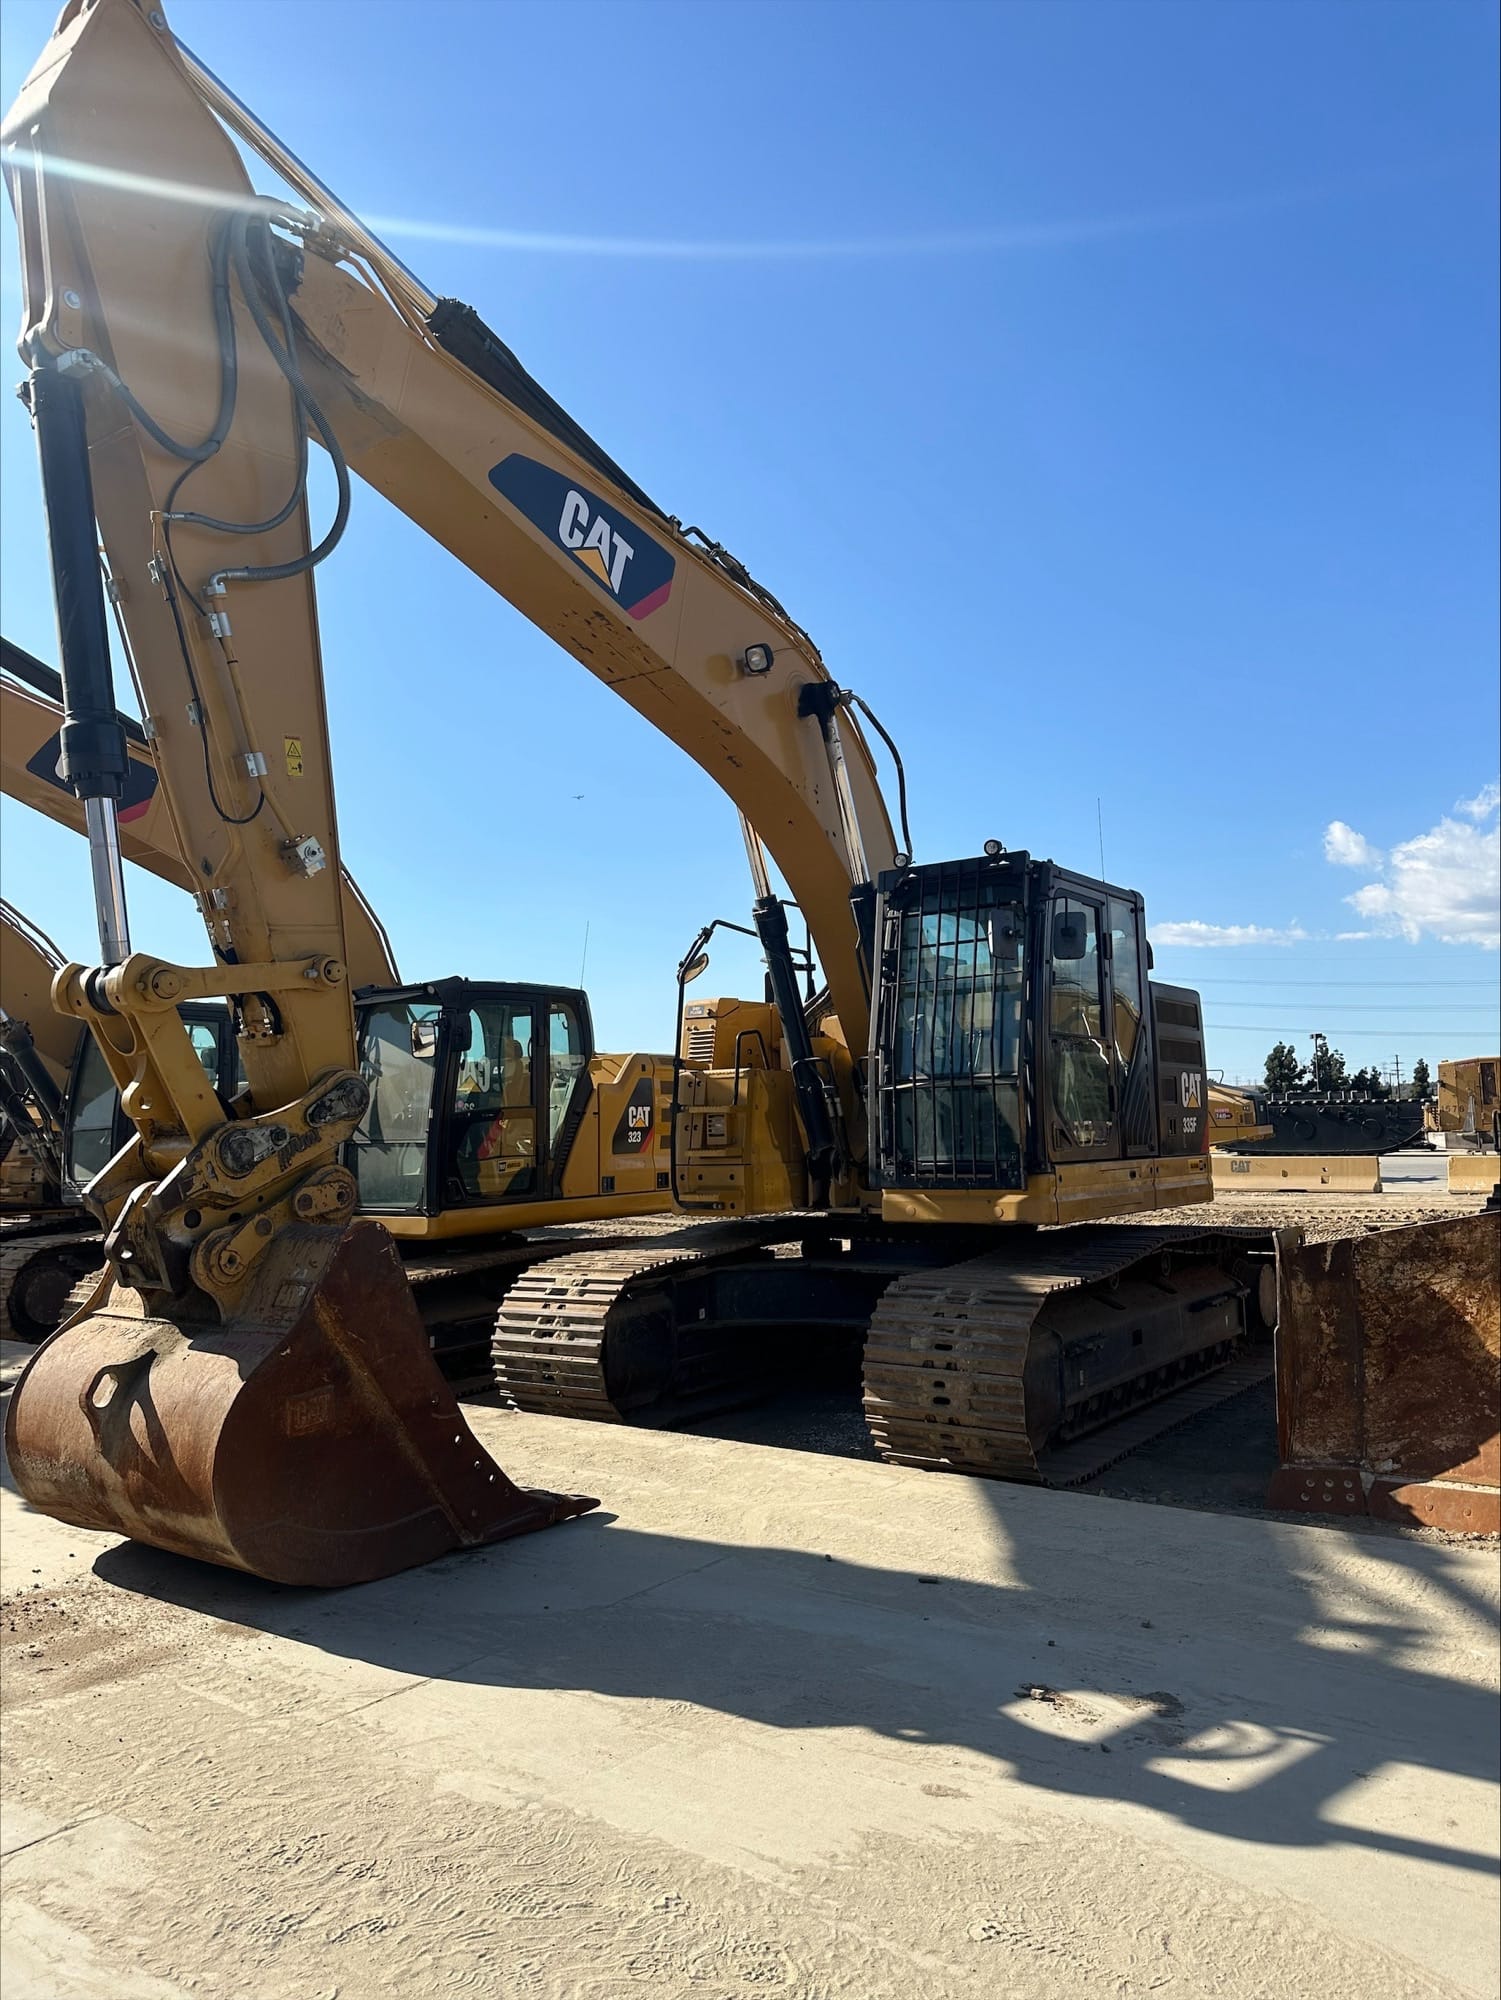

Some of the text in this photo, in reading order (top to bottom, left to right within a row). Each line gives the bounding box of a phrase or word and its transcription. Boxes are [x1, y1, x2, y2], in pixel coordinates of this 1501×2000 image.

[559, 490, 634, 595] CAT
[1181, 1072, 1201, 1108] CAT
[628, 1106, 650, 1128] CAT
[1183, 1117, 1197, 1133] 335F
[628, 1131, 641, 1143] 323
[1231, 1160, 1251, 1173] CAT
